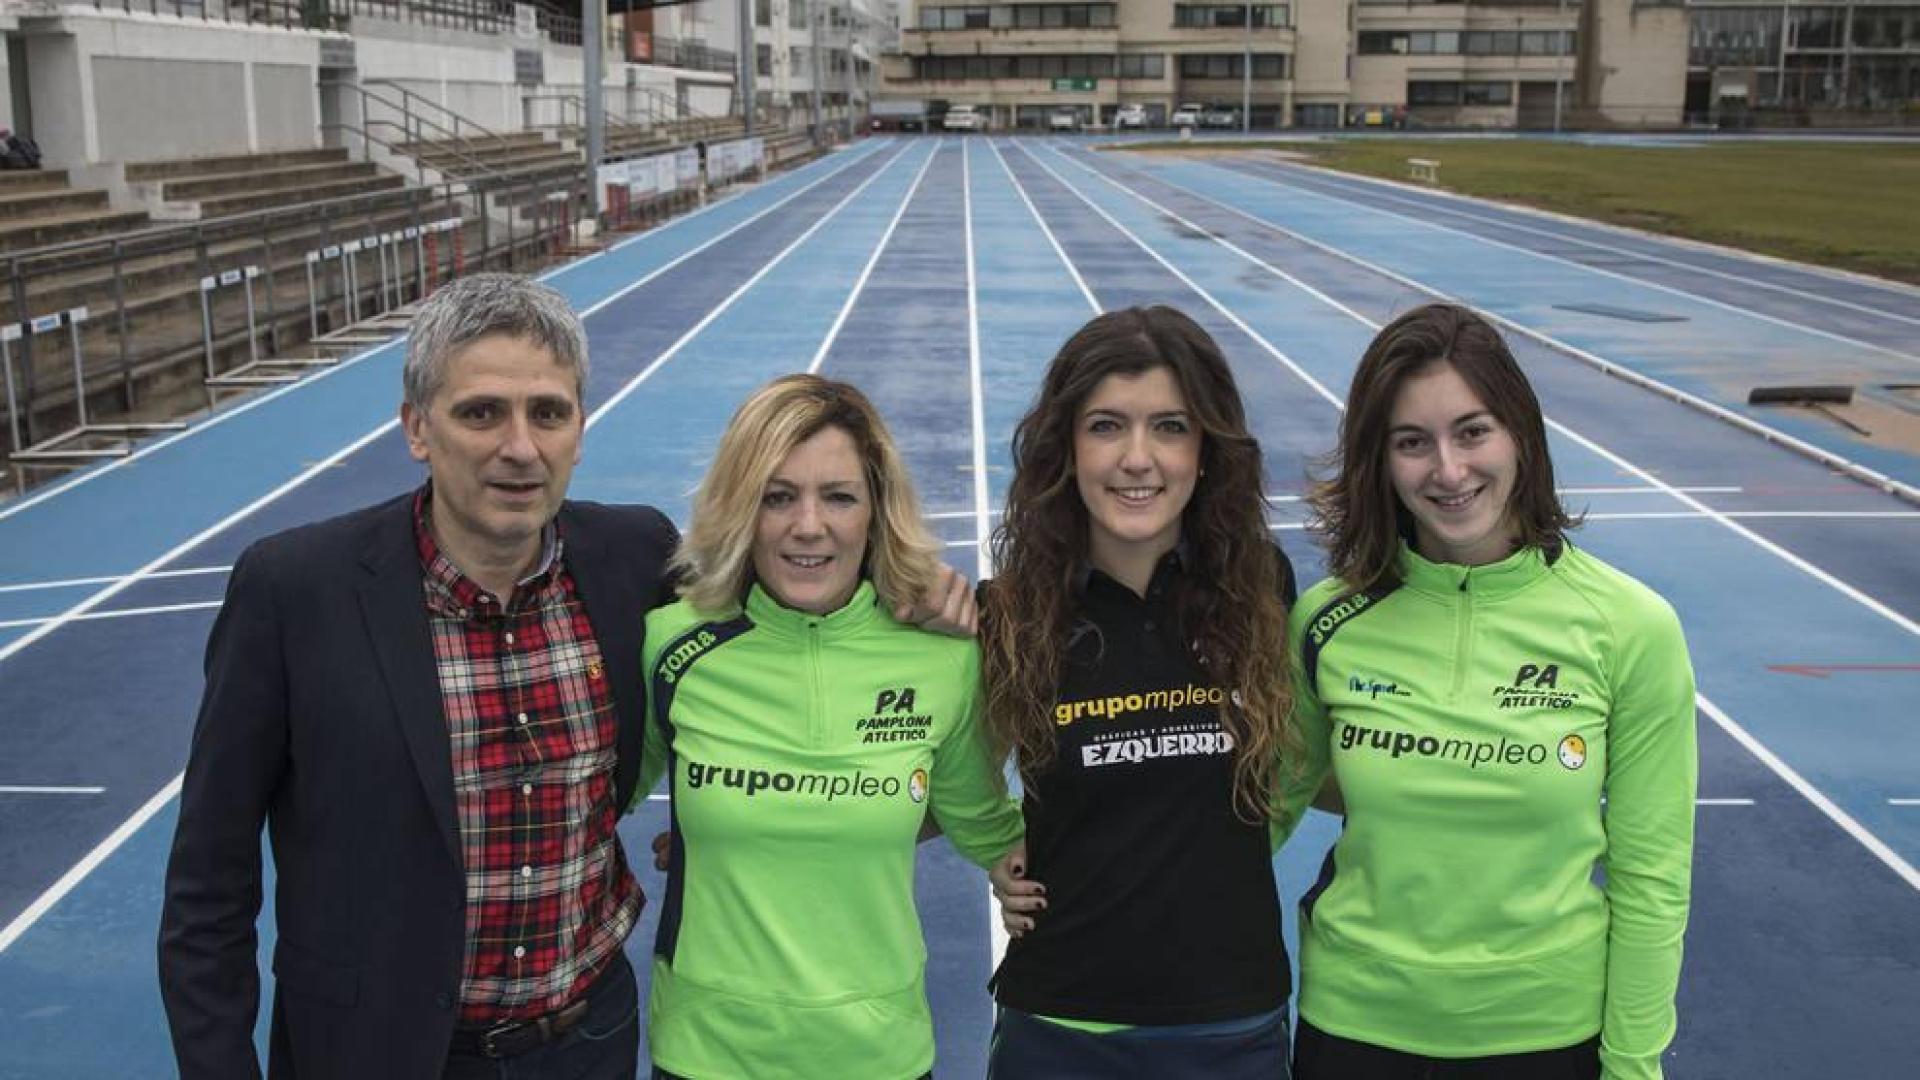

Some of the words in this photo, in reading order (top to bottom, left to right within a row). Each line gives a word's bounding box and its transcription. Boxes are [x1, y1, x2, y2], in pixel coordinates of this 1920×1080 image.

[1513, 663, 1560, 689] PA
[874, 687, 916, 715] PA
[1056, 683, 1223, 726] grupompleo
[856, 715, 932, 732] PAMPLONA
[863, 729, 926, 745] ATLETICO
[1082, 731, 1235, 768] EZQUERRO
[1340, 724, 1547, 769] grupompleo
[687, 761, 900, 801] grupompleo
